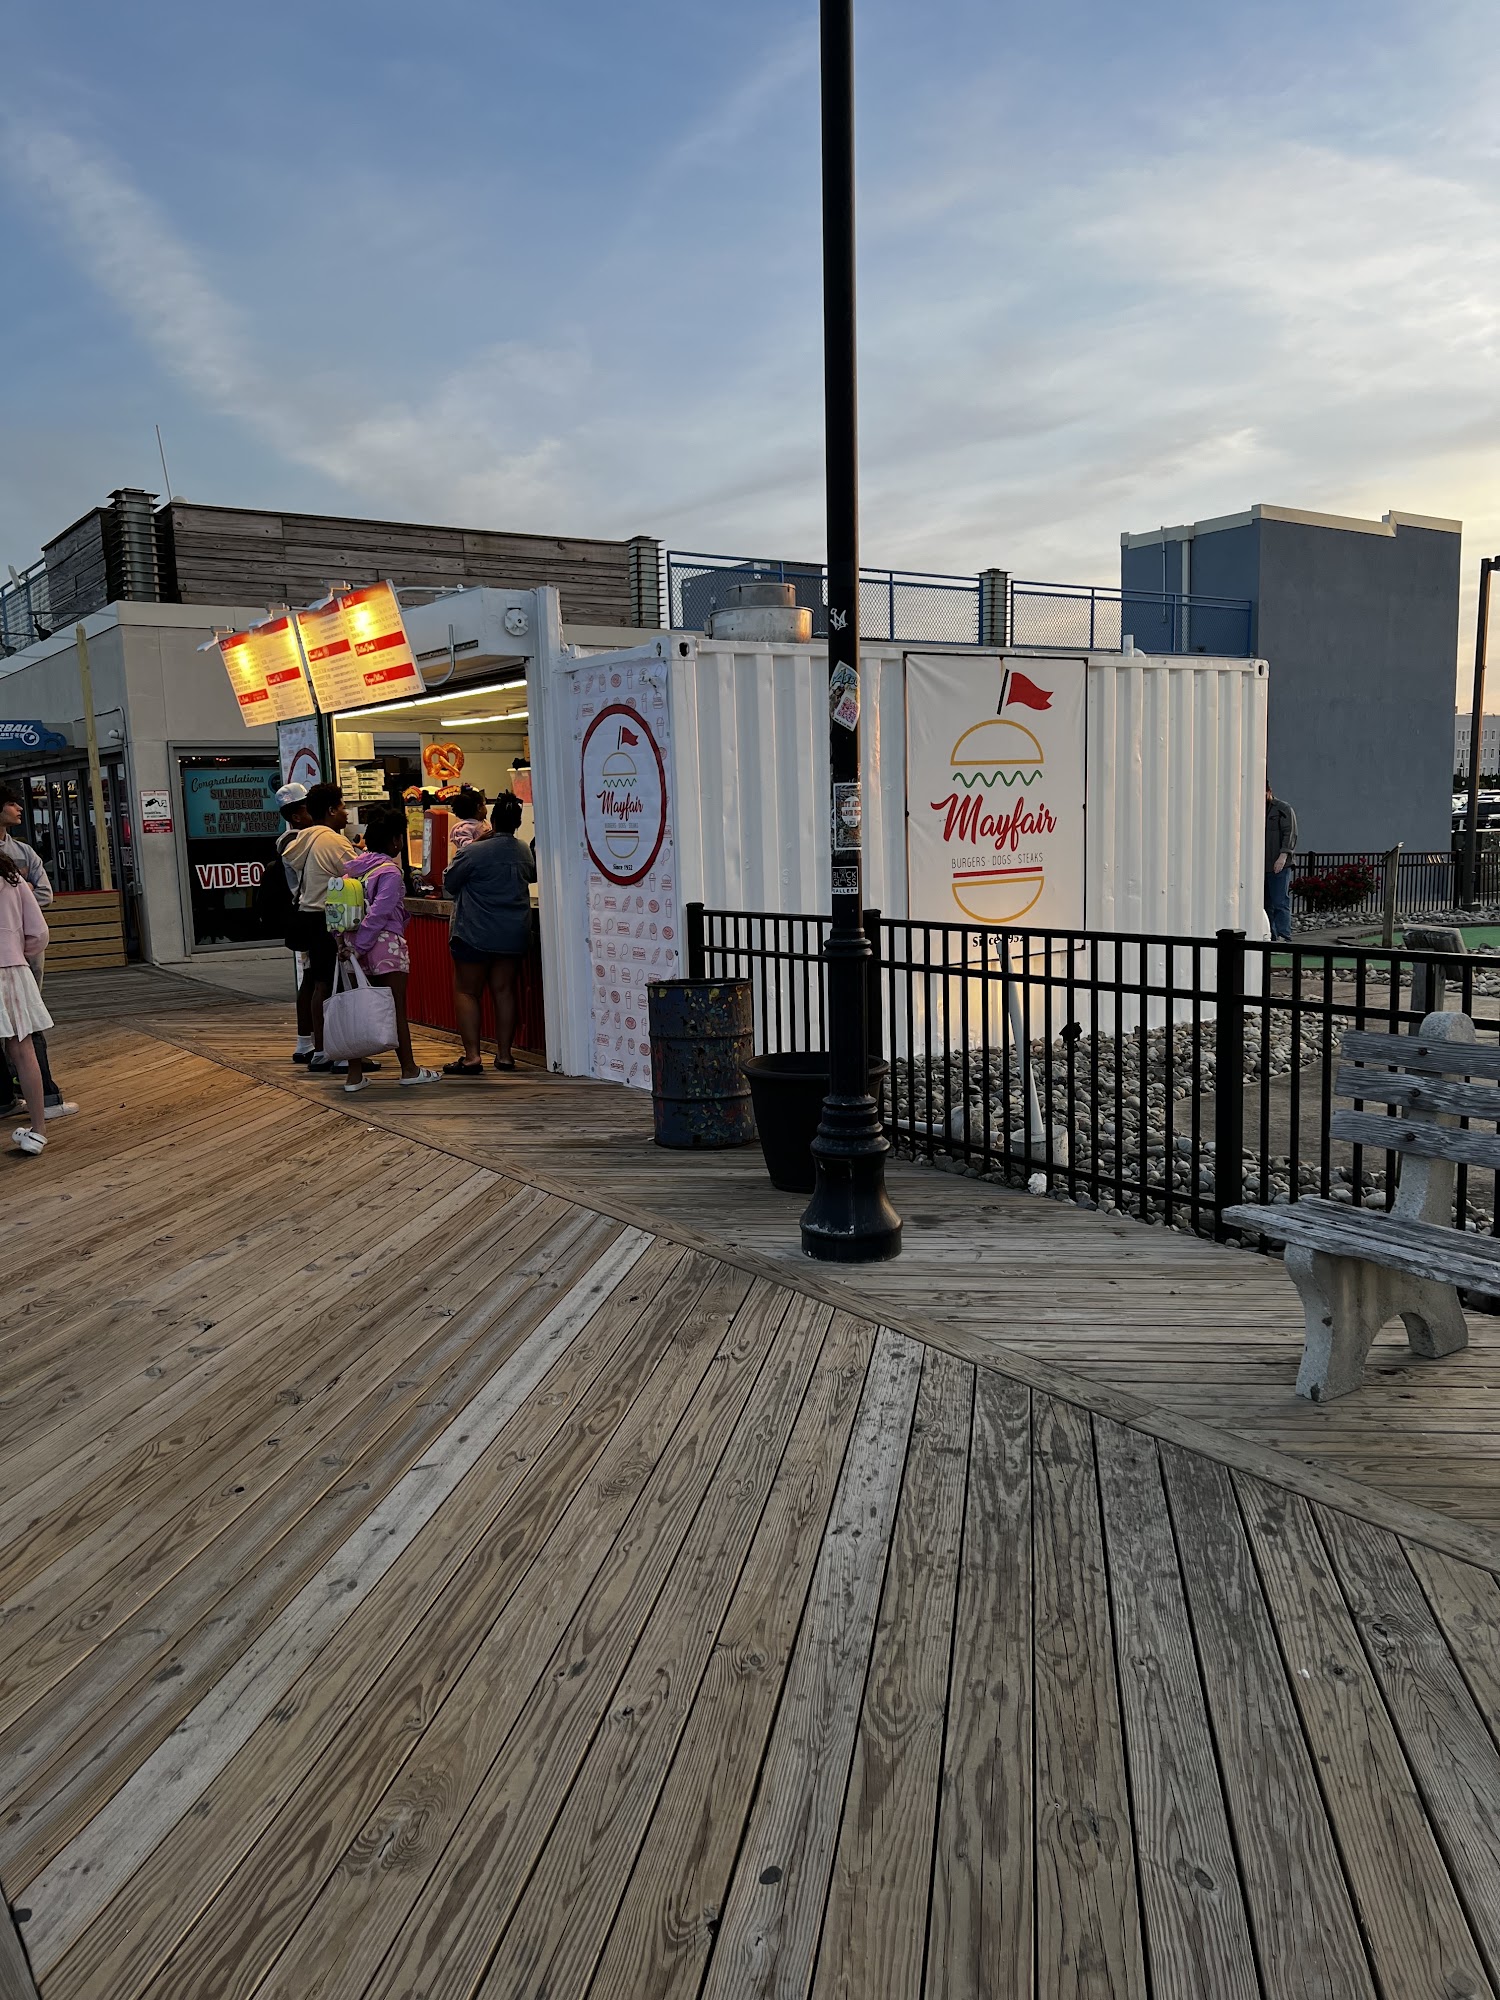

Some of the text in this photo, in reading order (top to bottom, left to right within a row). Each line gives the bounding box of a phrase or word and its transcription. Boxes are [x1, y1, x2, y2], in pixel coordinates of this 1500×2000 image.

[191, 774, 265, 793] Congratulations
[210, 788, 271, 800] SILVERBALL
[219, 799, 264, 810] MUSEUM
[596, 790, 644, 822] Mayfair
[219, 811, 280, 824] ATTRACTION
[930, 792, 1058, 852] Mayfair
[218, 823, 240, 834] NEW
[243, 822, 280, 833] JERSEY
[951, 852, 1044, 869] BURGERS DOGS STEAKS
[195, 862, 266, 890] VIDEO
